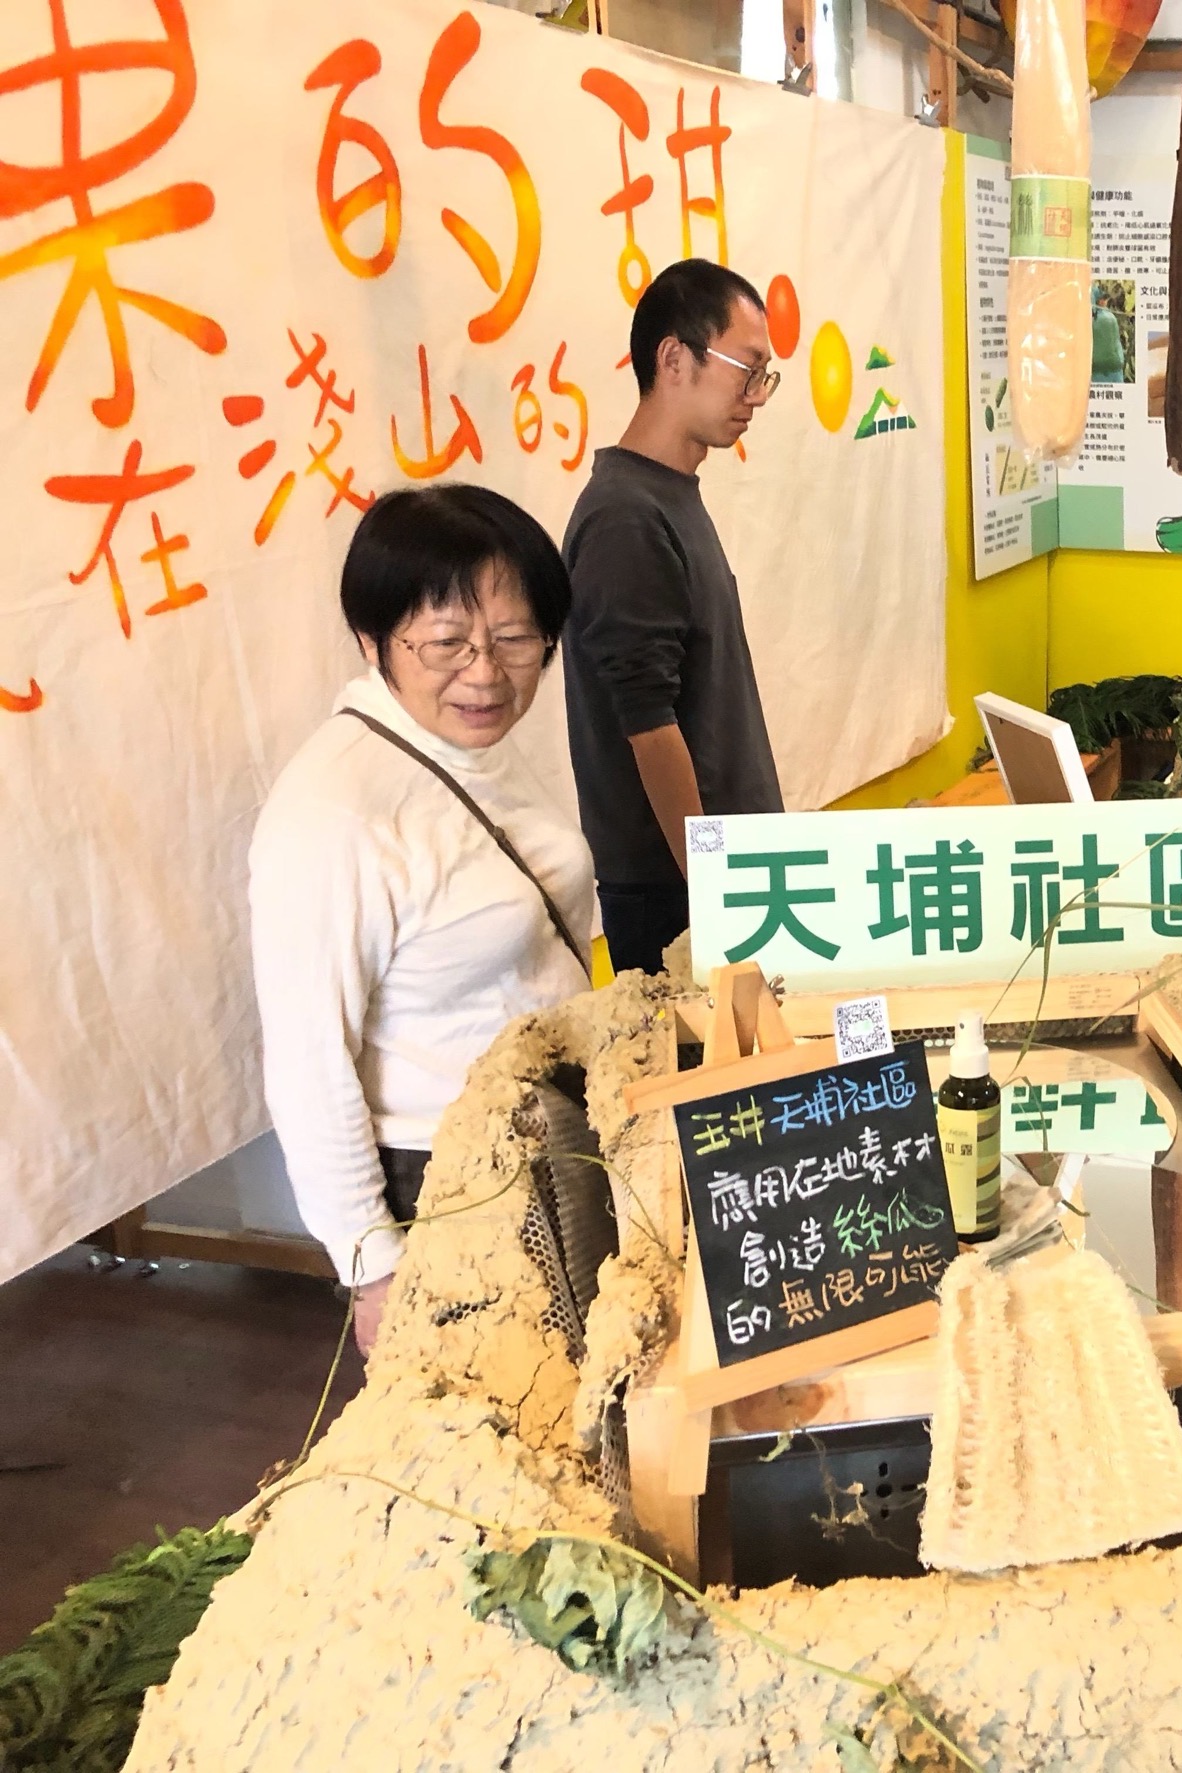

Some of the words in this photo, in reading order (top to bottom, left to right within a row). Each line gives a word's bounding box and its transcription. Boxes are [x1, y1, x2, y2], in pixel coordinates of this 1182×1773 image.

[1090, 190, 1133, 201] 健康功能
[708, 1126, 936, 1231] 應用在地素材
